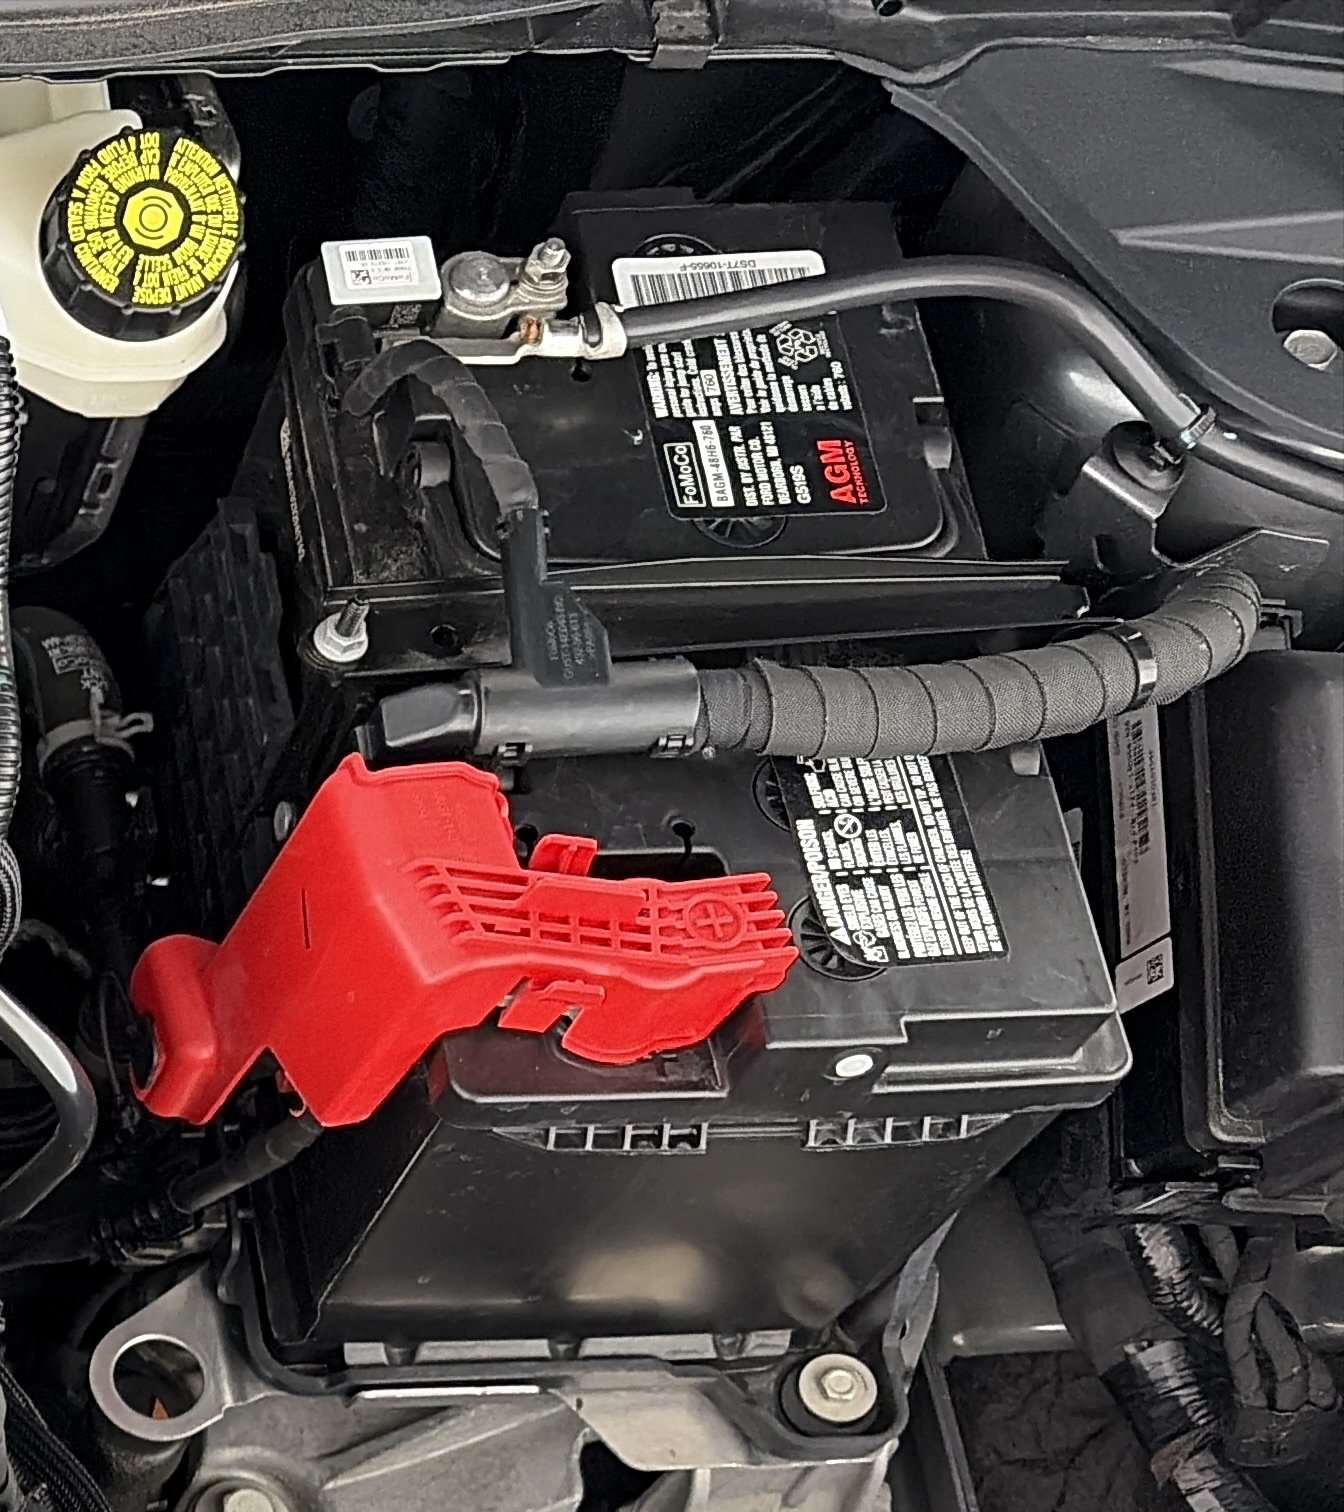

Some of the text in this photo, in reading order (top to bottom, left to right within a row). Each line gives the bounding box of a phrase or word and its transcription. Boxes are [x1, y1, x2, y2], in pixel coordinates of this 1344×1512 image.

[97, 138, 129, 167] FLUID
[140, 132, 159, 150] DOT
[100, 152, 139, 184] BEFORE
[140, 149, 160, 166] CAP
[173, 138, 221, 176] ATTENTION
[76, 159, 104, 190] FROM
[71, 188, 88, 200] A
[84, 178, 108, 230] REMOVING
[68, 201, 85, 242] SEALED
[222, 223, 238, 237] LE
[85, 231, 106, 254] USE
[74, 243, 119, 293] CONTAINER
[140, 273, 160, 289] DOT
[174, 274, 204, 301] AVANT
[703, 373, 717, 392] 760
[714, 338, 744, 414] AVERTISSEMENT
[670, 444, 698, 503] FoMoCo
[751, 452, 768, 481] MOTOR
[817, 440, 856, 503] AGM
[844, 440, 868, 504] TECHNOLOGY
[759, 482, 774, 505] FORD
[790, 465, 811, 503] G519S
[796, 819, 844, 927] DANGER/POISON
[956, 919, 970, 934] OUT
[961, 934, 976, 953] KEEP
